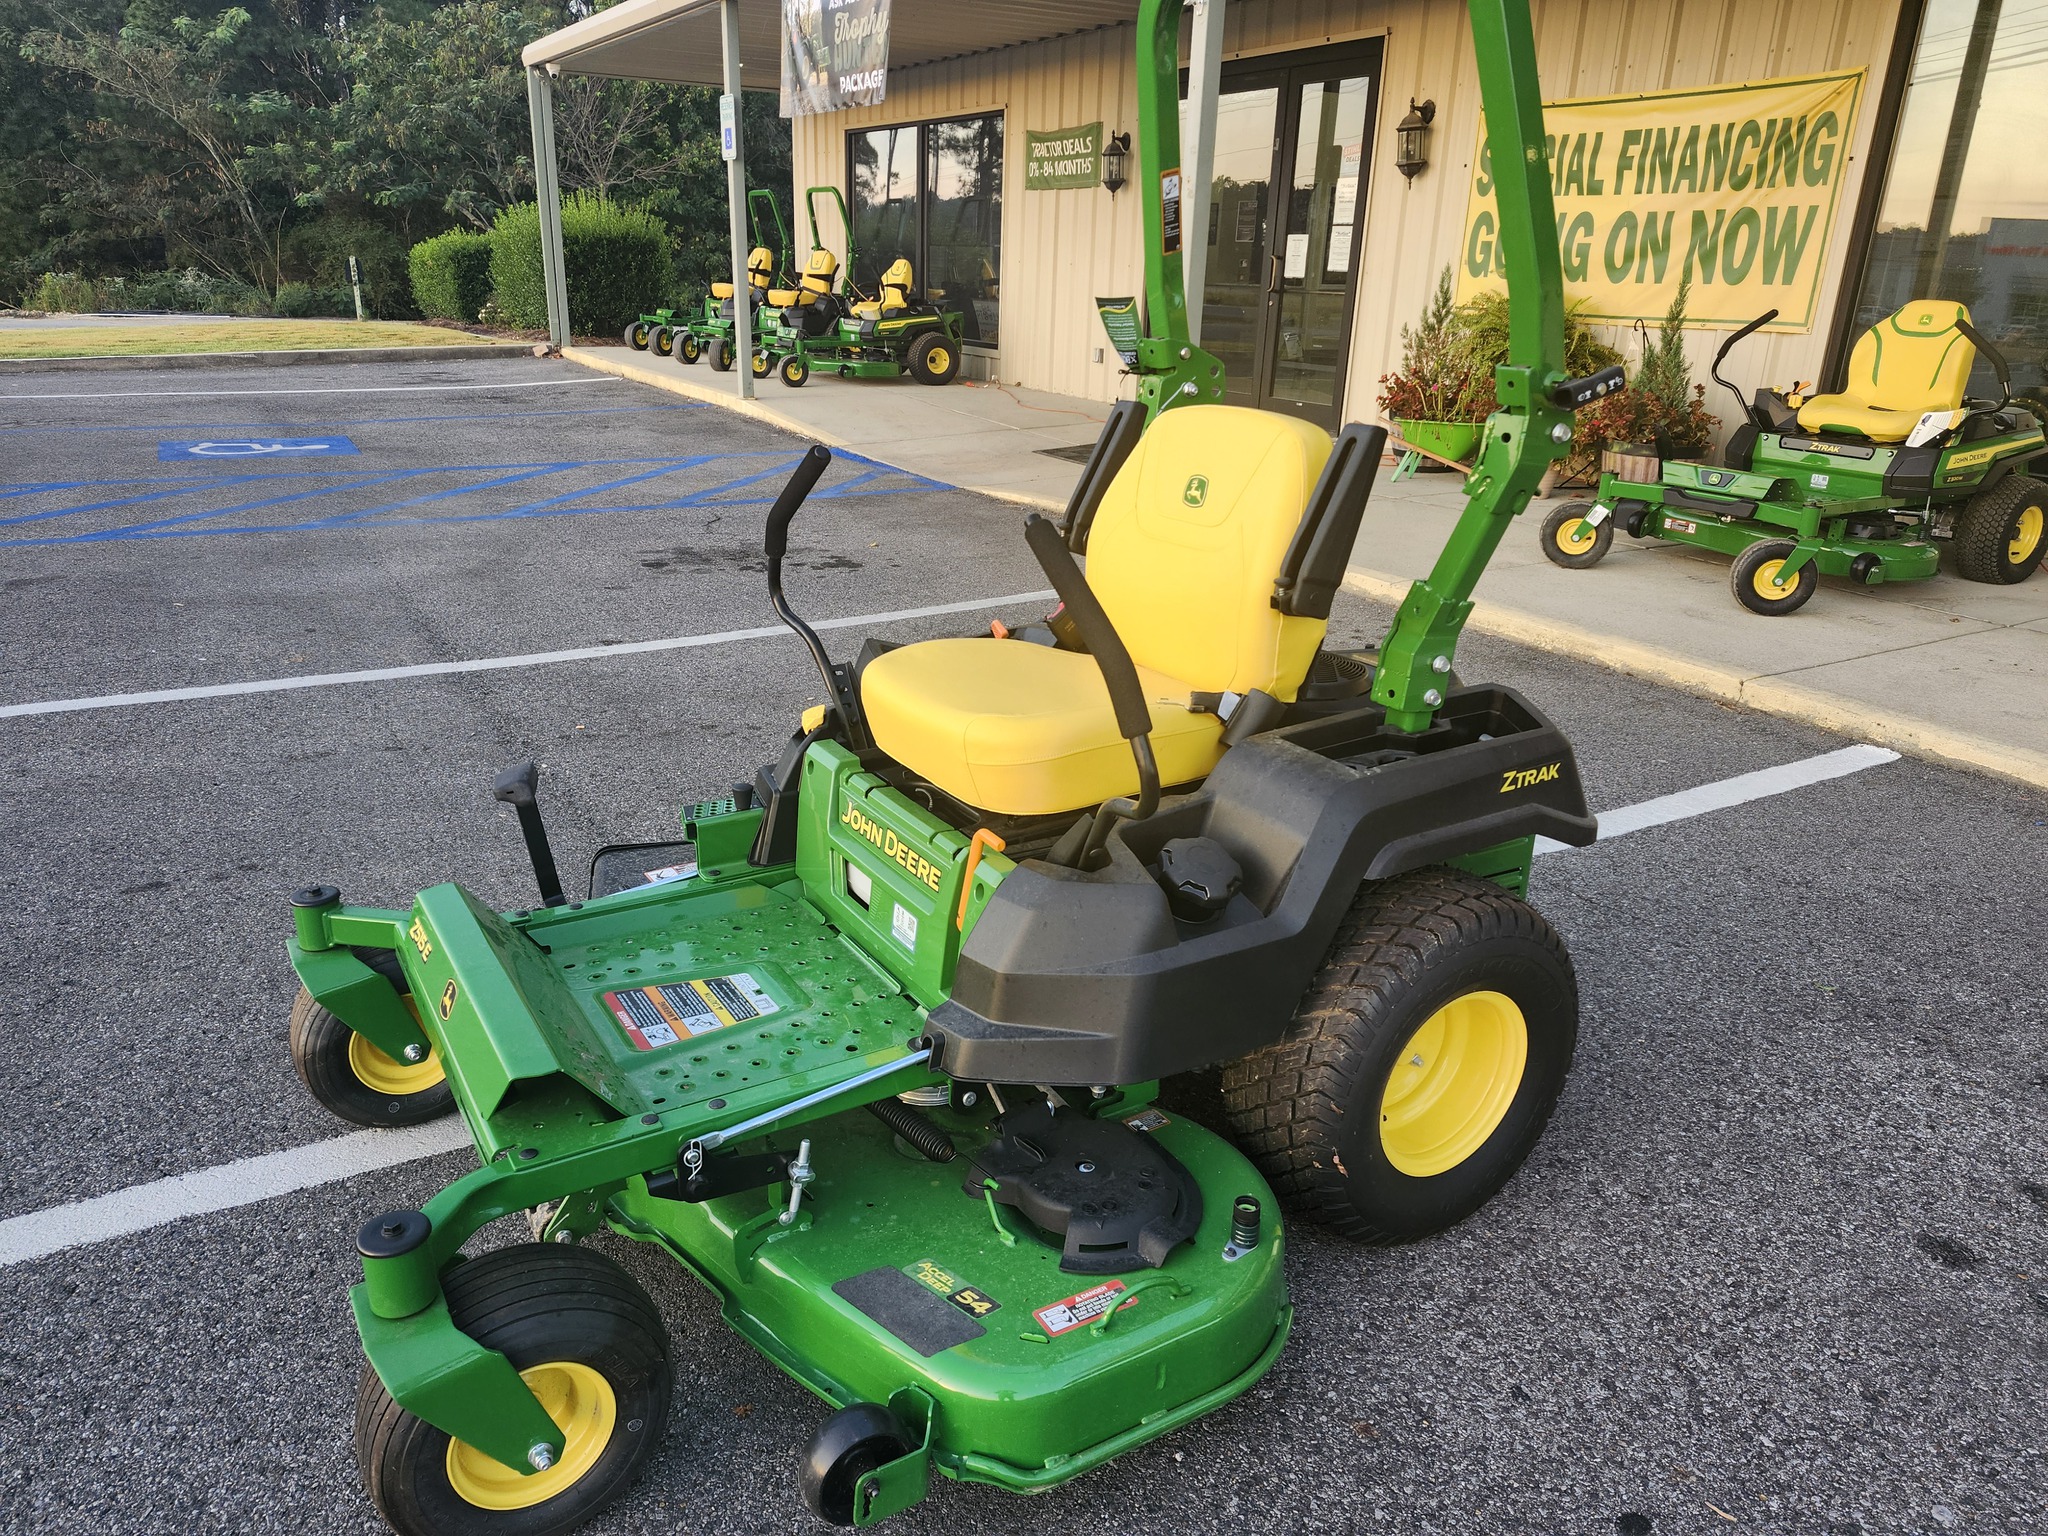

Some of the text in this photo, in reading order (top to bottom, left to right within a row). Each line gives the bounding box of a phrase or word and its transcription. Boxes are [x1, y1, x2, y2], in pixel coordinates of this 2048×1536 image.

[834, 6, 889, 45] Trophy
[840, 68, 884, 94] PACKAGE
[1031, 136, 1092, 158] TRACTOR DEALS
[1476, 110, 1839, 197] SIAL FINANCING
[1028, 161, 1039, 177] 0%
[1043, 161, 1054, 177] 84
[1604, 210, 1675, 285] ON
[1679, 204, 1820, 286] NOW
[1809, 441, 1841, 453] ZTRAK
[1952, 452, 1988, 465] JOHN DEERE
[1500, 762, 1562, 793] ZTRAK
[842, 800, 942, 893] JOHN DEERE
[917, 1271, 951, 1293] DEEP
[918, 1262, 955, 1287] ACCEL
[954, 1290, 993, 1314] 54
[1081, 1285, 1108, 1300] DANGER
